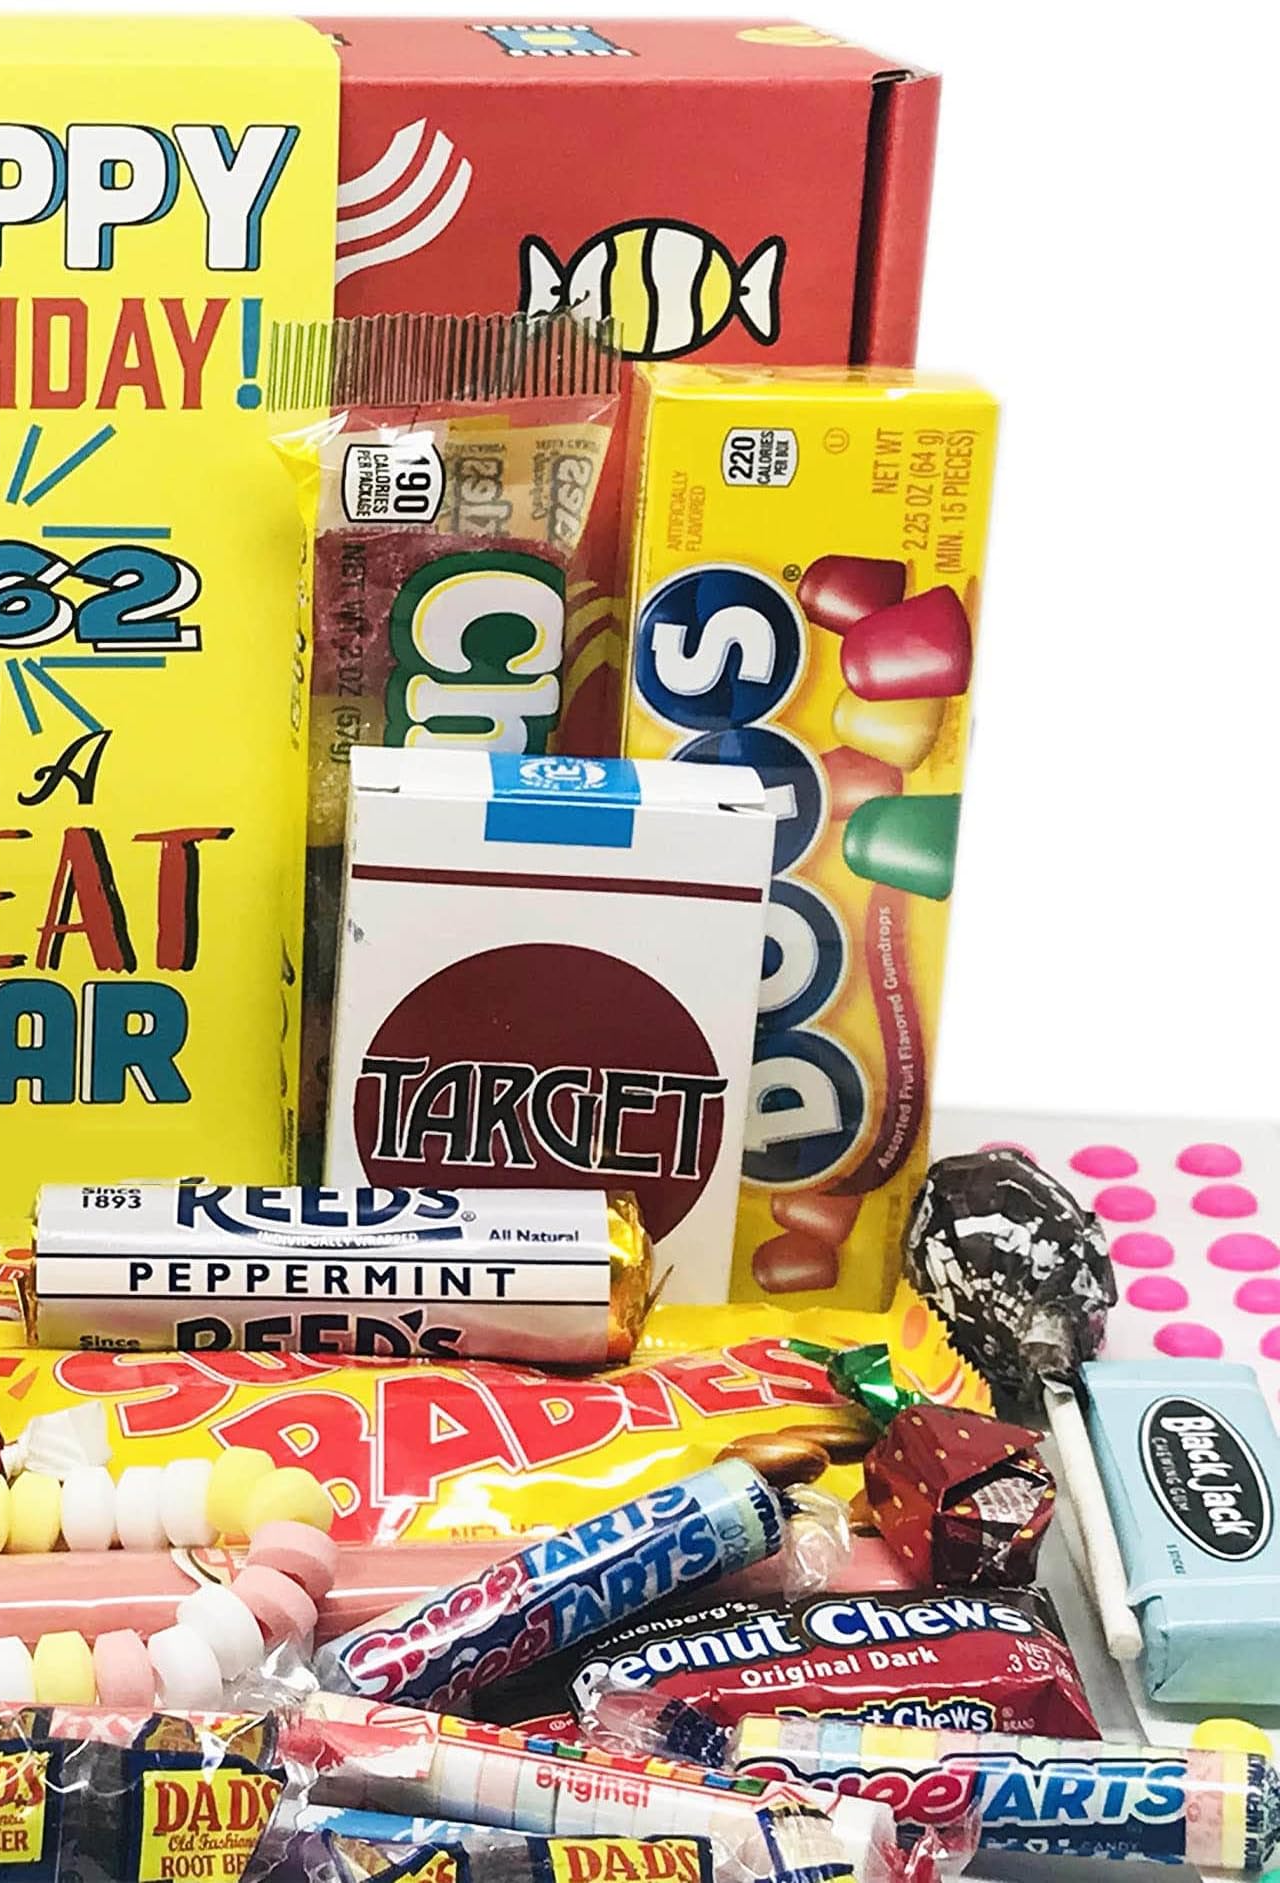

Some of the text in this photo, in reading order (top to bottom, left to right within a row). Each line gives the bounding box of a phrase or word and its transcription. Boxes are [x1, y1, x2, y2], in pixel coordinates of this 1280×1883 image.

[729, 437, 756, 479] 220
[757, 431, 775, 484] CALORIES
[774, 460, 788, 476] PER
[872, 428, 904, 494] NET WT
[942, 429, 979, 496] PIECES)
[356, 450, 373, 516] PER PACKAGE
[373, 454, 391, 513] CALORIES
[394, 455, 431, 513] 190
[906, 484, 933, 507] OZ
[667, 470, 688, 551] ARTIFICIALLY
[686, 485, 706, 552] FLAVORED
[902, 512, 930, 550] 2.25
[941, 503, 967, 522] 15
[18, 730, 112, 806] A
[652, 606, 844, 1152] DOS
[878, 905, 914, 1169] Assorted Fruit Flavored Gumdrops
[361, 1056, 728, 1180] TARGET
[82, 1195, 141, 1208] 1893
[489, 1229, 579, 1242] All Natural
[130, 1262, 518, 1298] PEPPERMINT
[80, 1335, 141, 1349] Since
[1160, 1416, 1257, 1536] Black Jack
[571, 1614, 798, 1712] Peanut
[809, 1599, 1032, 1644] Chews
[740, 1645, 939, 1689] Original Dark
[1015, 1639, 1052, 1662] NET
[161, 1855, 216, 1878] ROOT
[168, 1833, 194, 1852] Old
[565, 1838, 700, 1883] DAD'S
